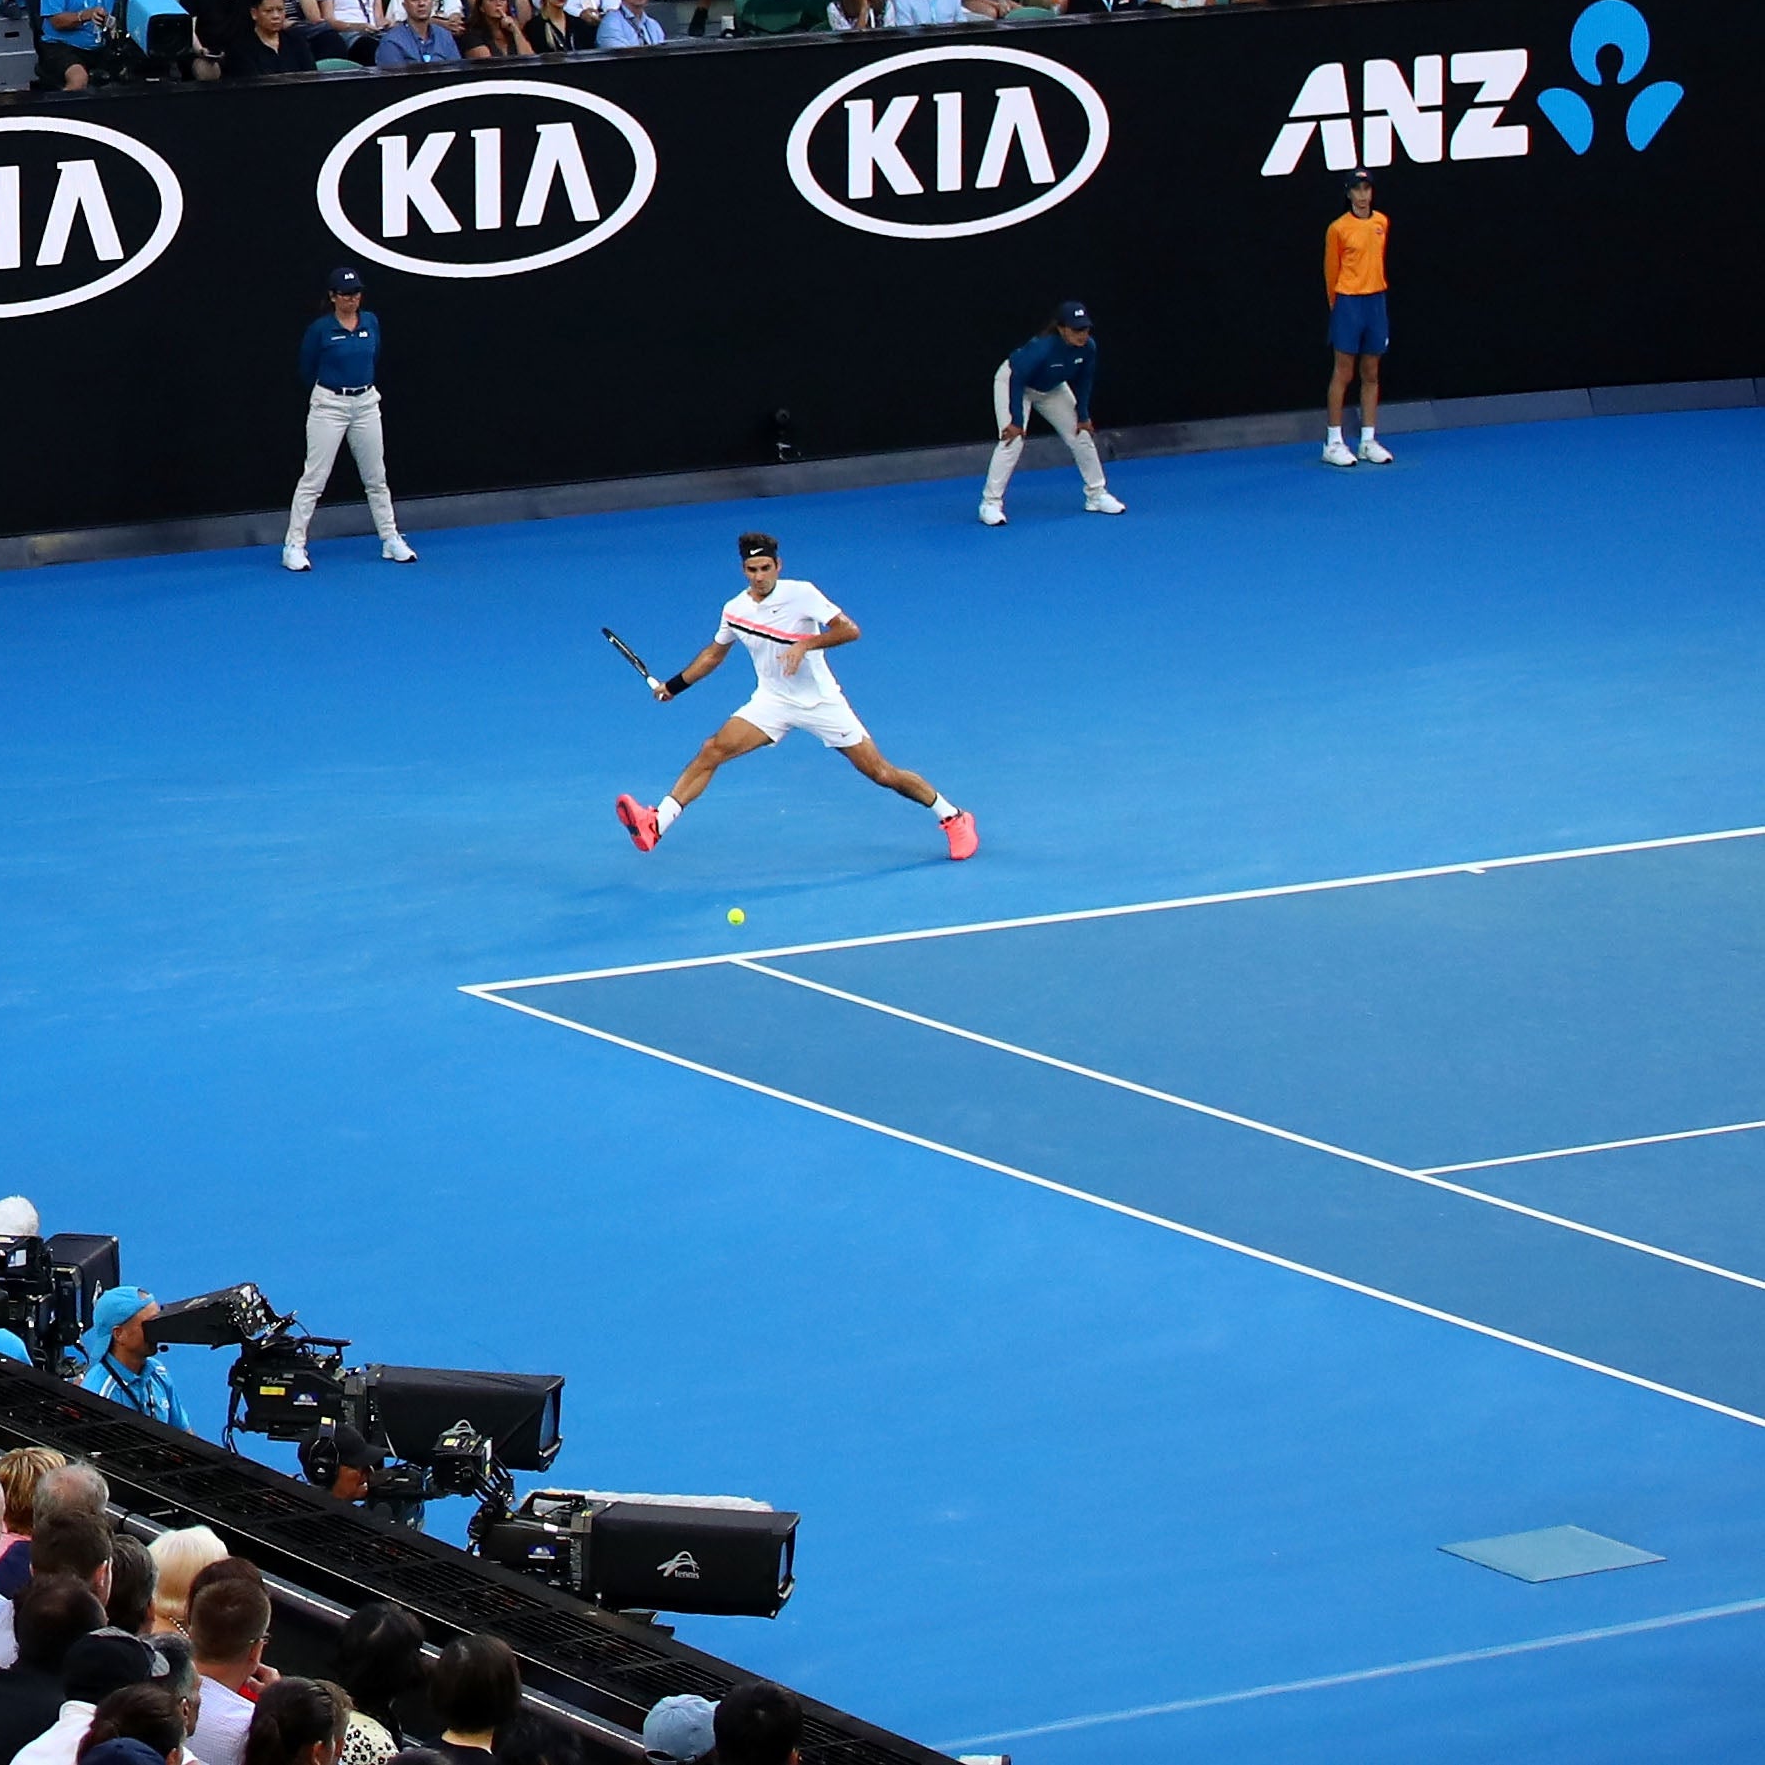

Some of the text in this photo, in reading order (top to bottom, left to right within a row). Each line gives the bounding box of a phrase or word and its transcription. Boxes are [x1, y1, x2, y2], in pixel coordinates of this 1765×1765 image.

[845, 87, 1056, 199] KIA
[1261, 48, 1528, 176] ANZ
[378, 123, 599, 238] KIA
[674, 1569, 699, 1580] tennis
